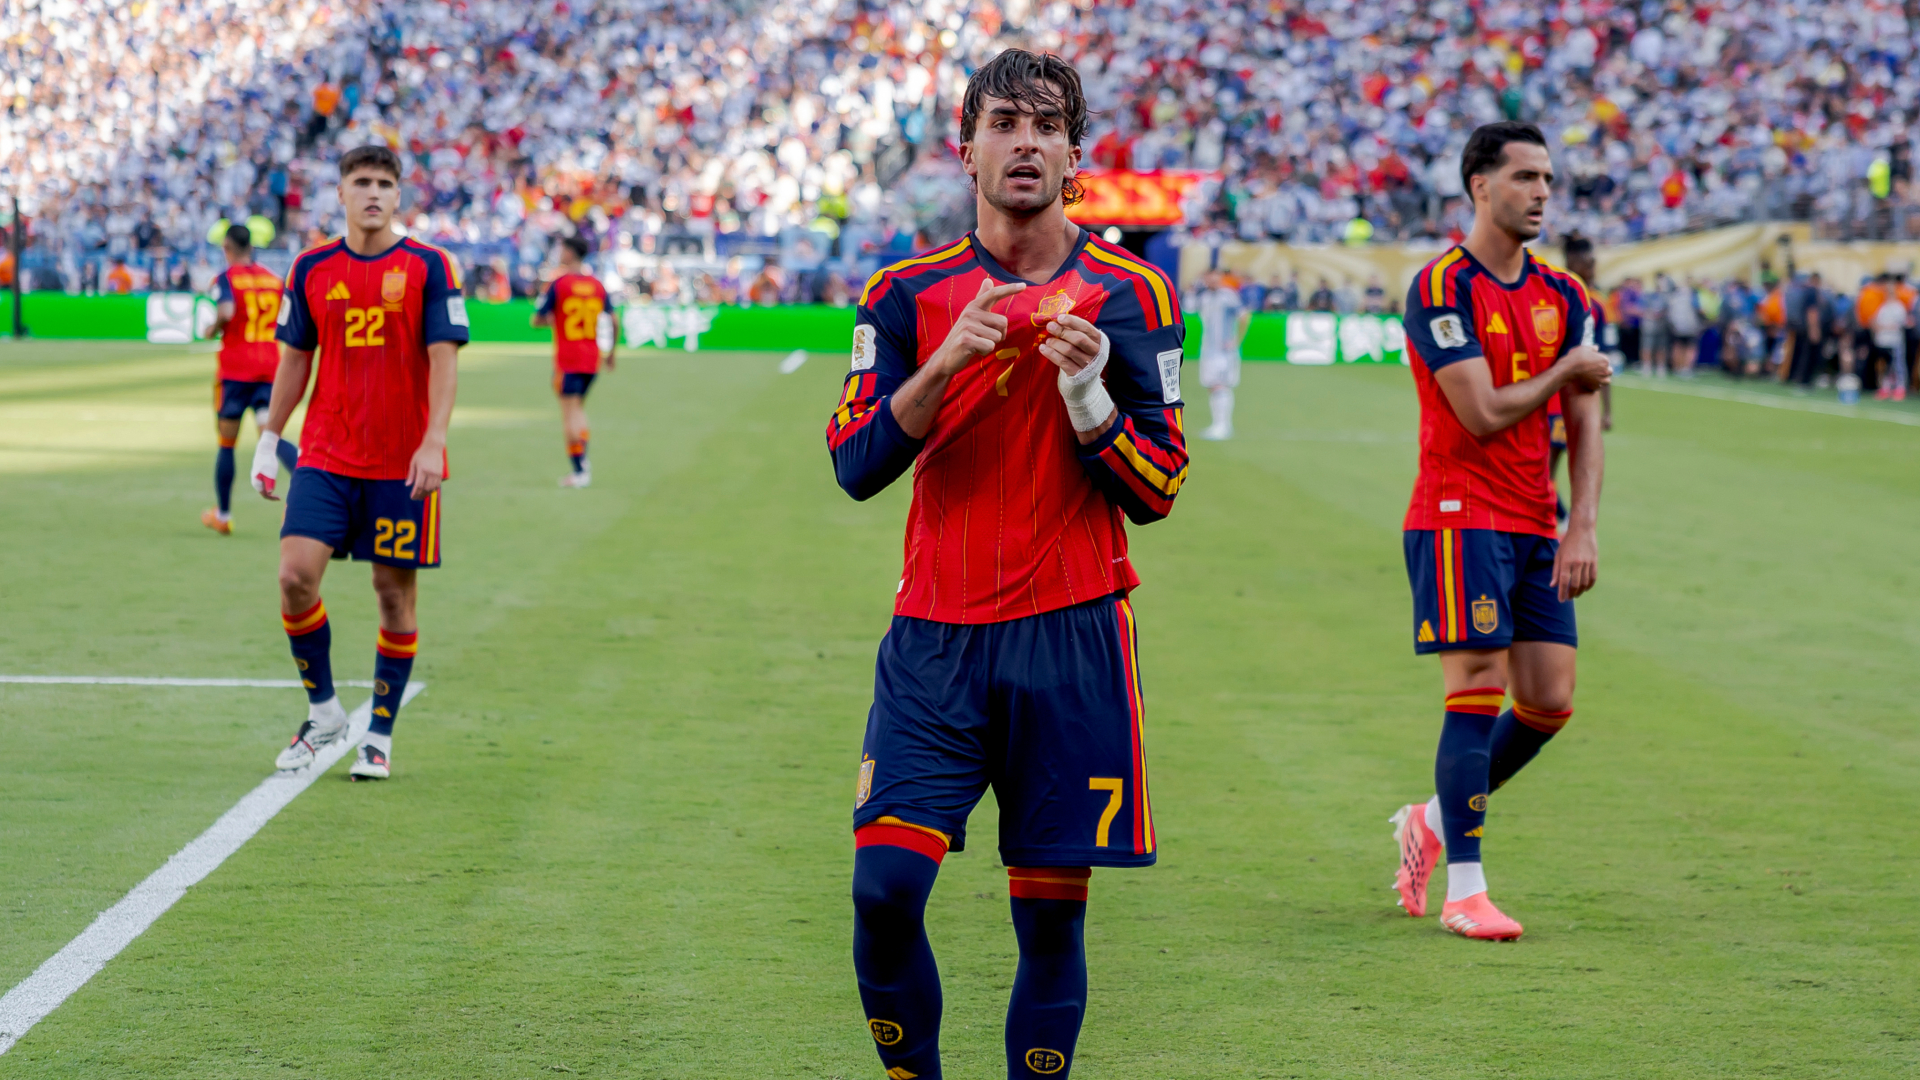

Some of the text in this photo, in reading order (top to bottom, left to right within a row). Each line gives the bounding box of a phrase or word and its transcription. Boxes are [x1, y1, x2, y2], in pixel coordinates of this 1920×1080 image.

[243, 290, 279, 343] 12
[345, 306, 385, 347] 22
[995, 347, 1020, 396] 7
[374, 517, 417, 560] 22
[1089, 777, 1123, 847] 7
